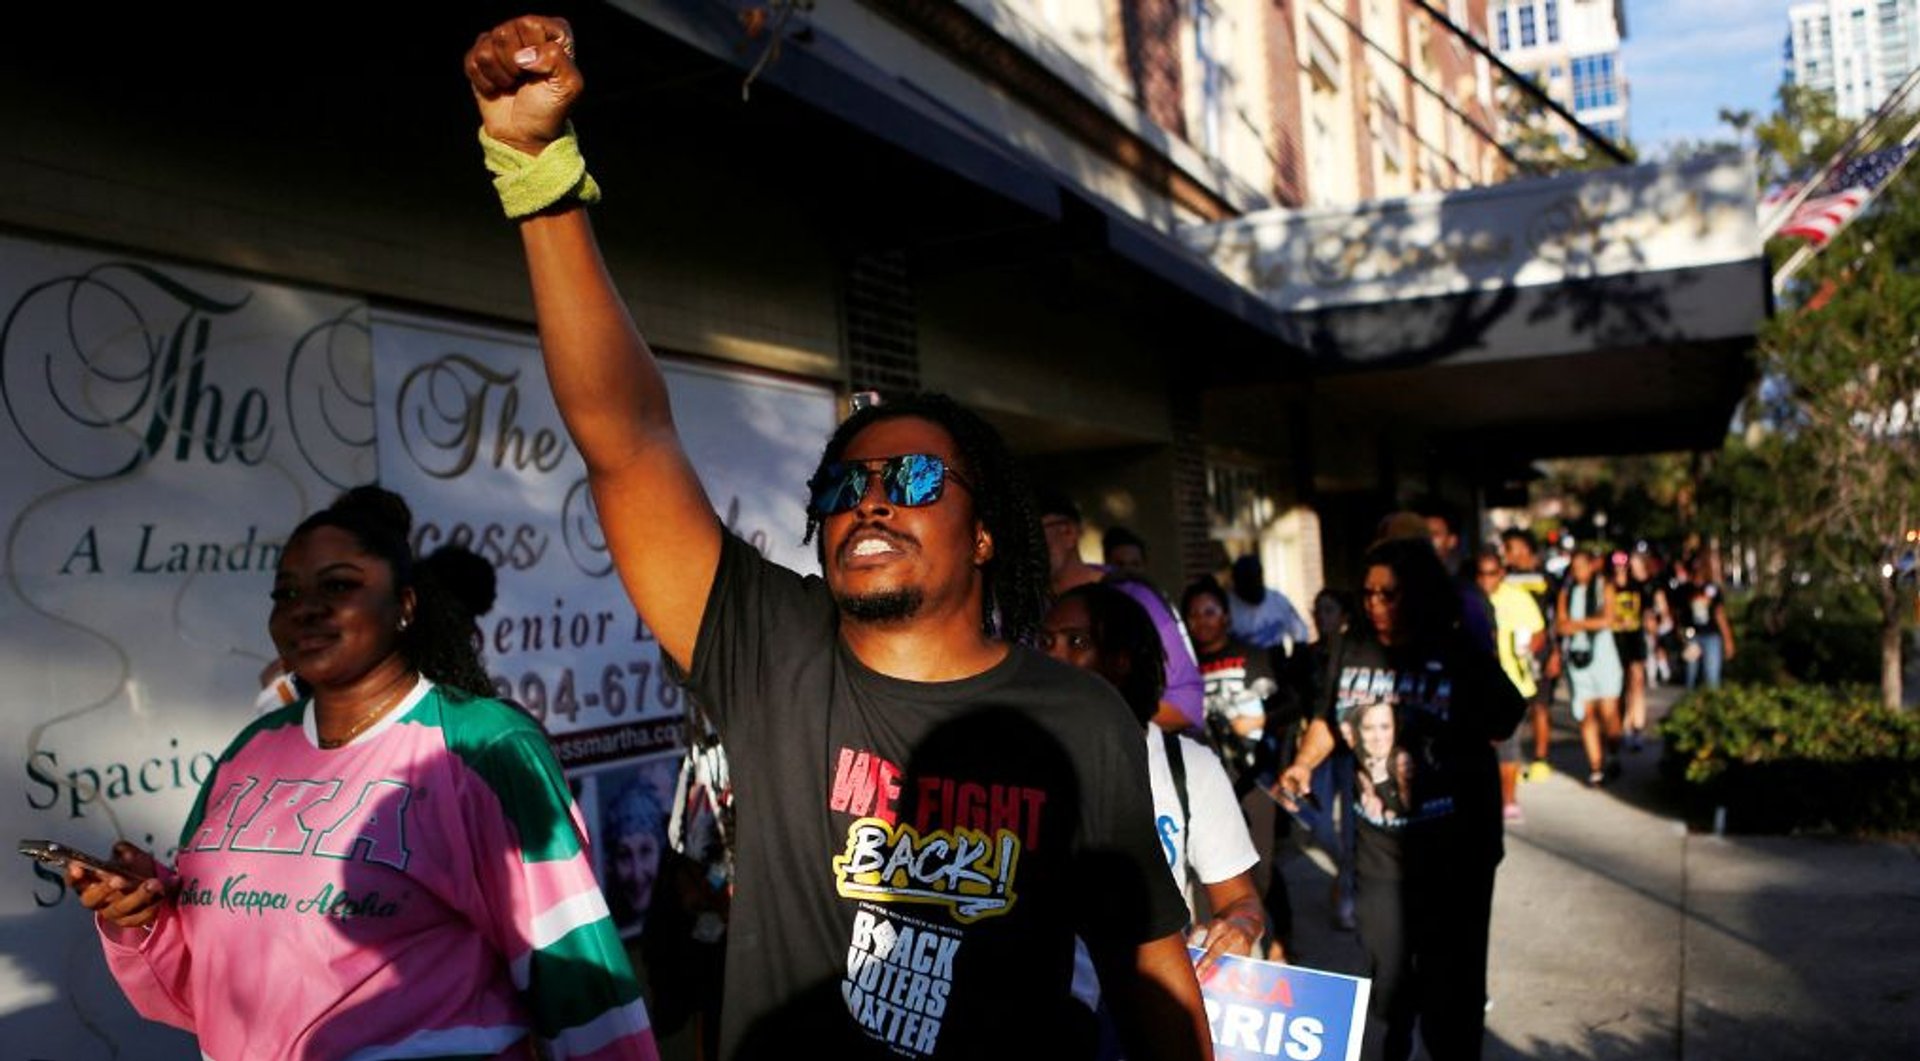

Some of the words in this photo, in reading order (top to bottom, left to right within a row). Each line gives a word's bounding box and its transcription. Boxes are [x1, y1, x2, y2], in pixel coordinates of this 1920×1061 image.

[2, 262, 274, 482] The
[397, 354, 564, 480] The
[58, 526, 102, 575] A
[830, 747, 904, 826] WE
[913, 775, 1046, 851] FIGHT
[841, 826, 1014, 893] BACK!
[220, 873, 290, 917] Kappa
[297, 883, 398, 922] Alpha
[841, 979, 942, 1056] MATTER
[847, 946, 951, 1019] VOTERS
